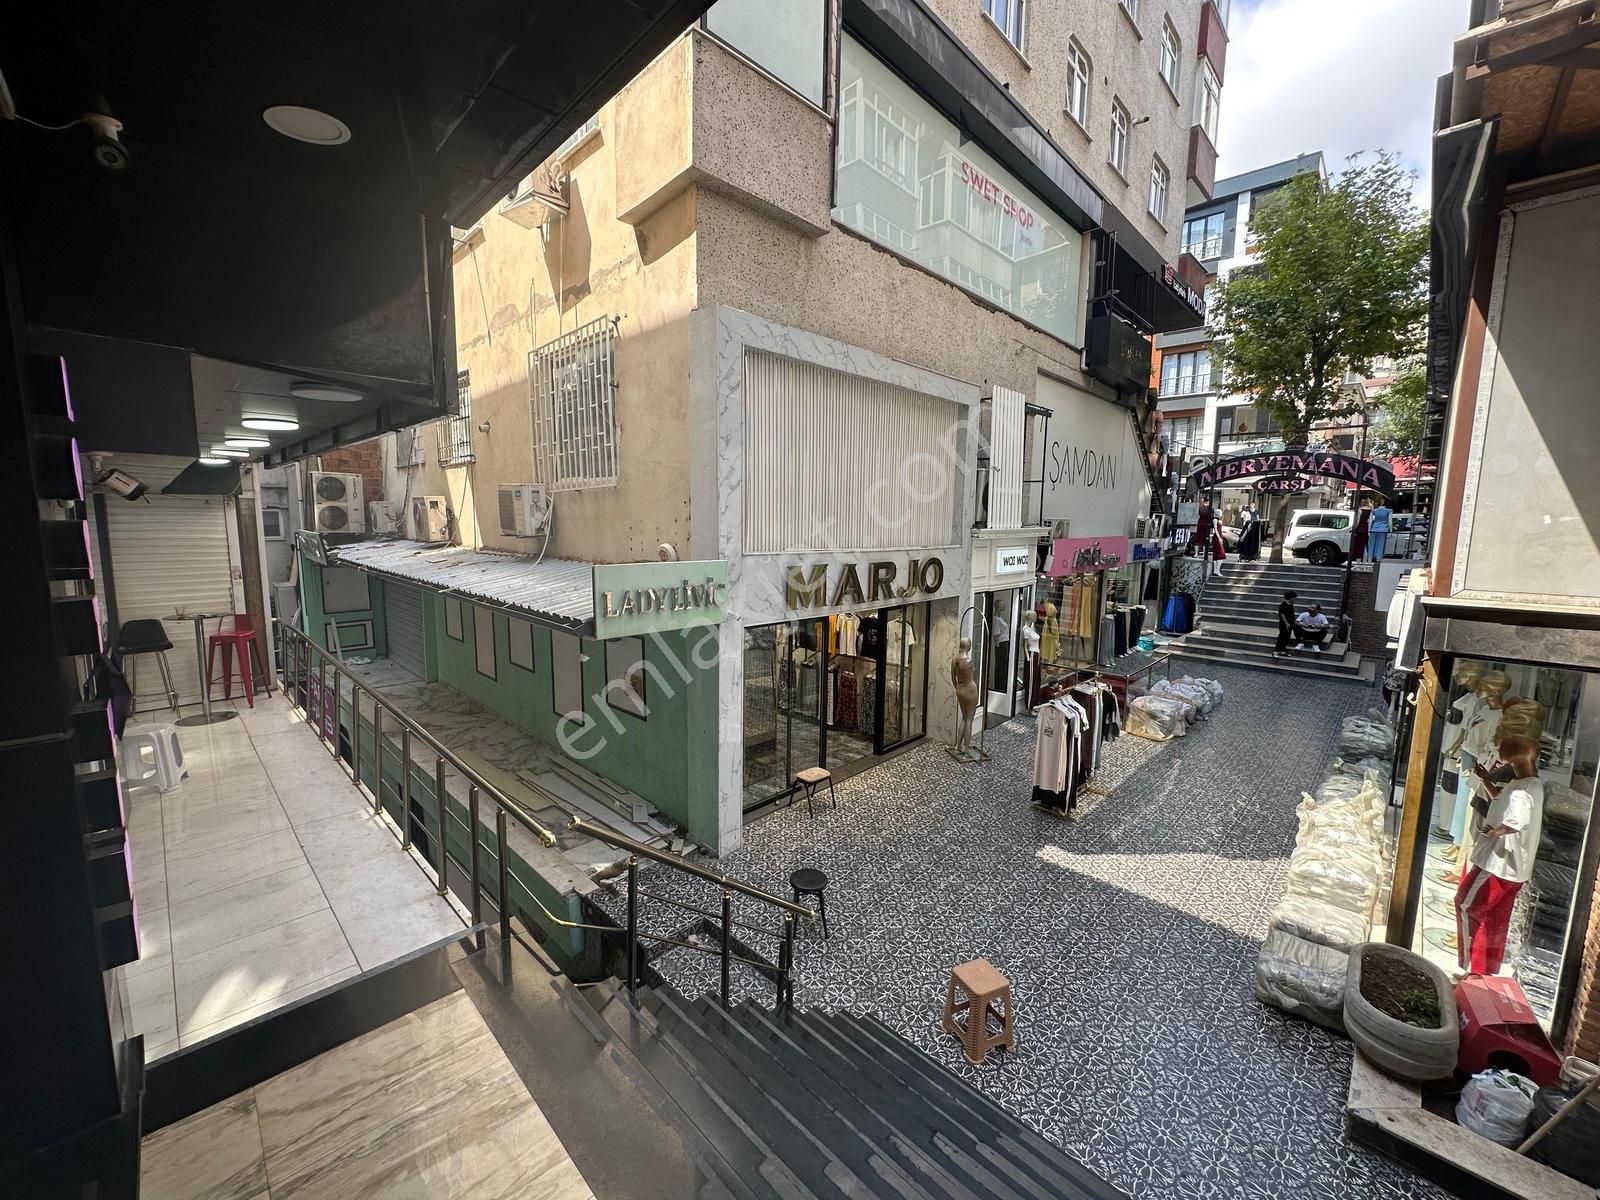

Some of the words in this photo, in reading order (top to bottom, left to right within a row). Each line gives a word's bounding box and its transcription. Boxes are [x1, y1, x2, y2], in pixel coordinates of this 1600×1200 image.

[961, 160, 999, 206] SWET
[1003, 194, 1034, 229] SHOP
[1049, 441, 1117, 491] ŞAMDAN
[1199, 454, 1381, 488] MERYEMANA
[1257, 480, 1306, 492] ÇARŞI
[786, 556, 945, 611] MARJO
